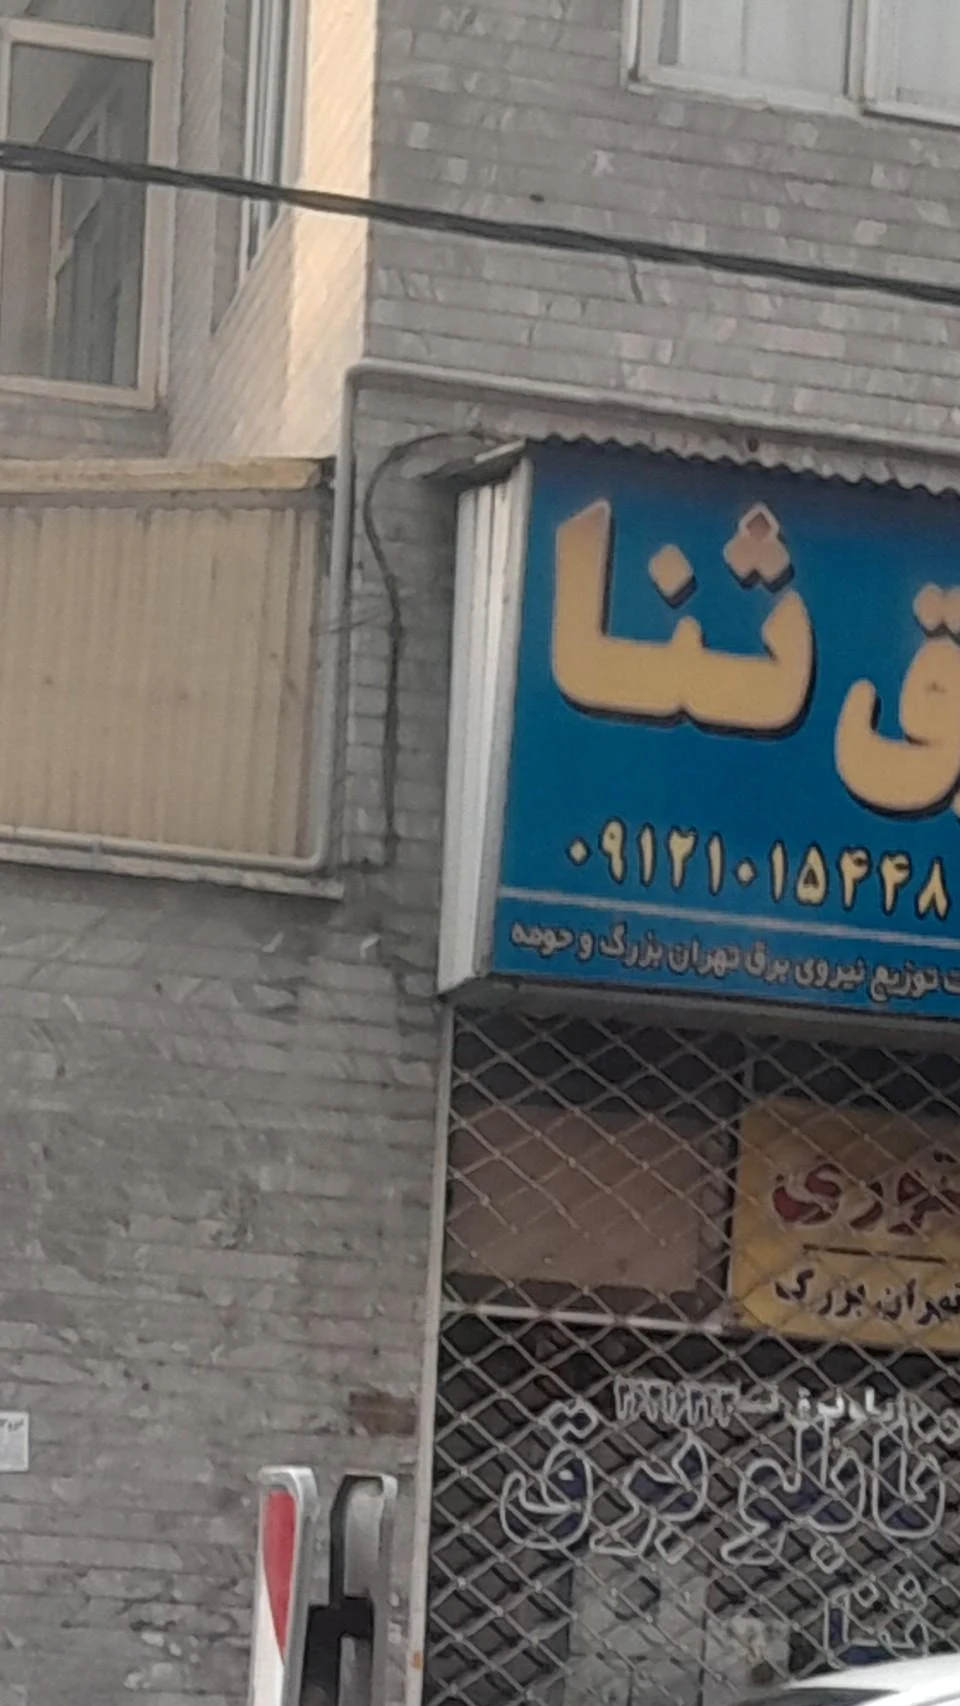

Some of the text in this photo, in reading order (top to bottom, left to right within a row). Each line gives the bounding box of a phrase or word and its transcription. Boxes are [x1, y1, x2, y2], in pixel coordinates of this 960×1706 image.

[551, 498, 817, 743] ثنا
[566, 816, 953, 922] ۰۹۱۲۱۰۱۵۴۴۸
[510, 921, 575, 958] حومه
[575, 923, 595, 961] و
[600, 920, 665, 970] بزرگ
[666, 938, 742, 979] تهران
[742, 938, 790, 984] برق
[794, 954, 868, 991] نیروی
[869, 957, 940, 1004] توزیع
[500, 1400, 709, 1564] برق
